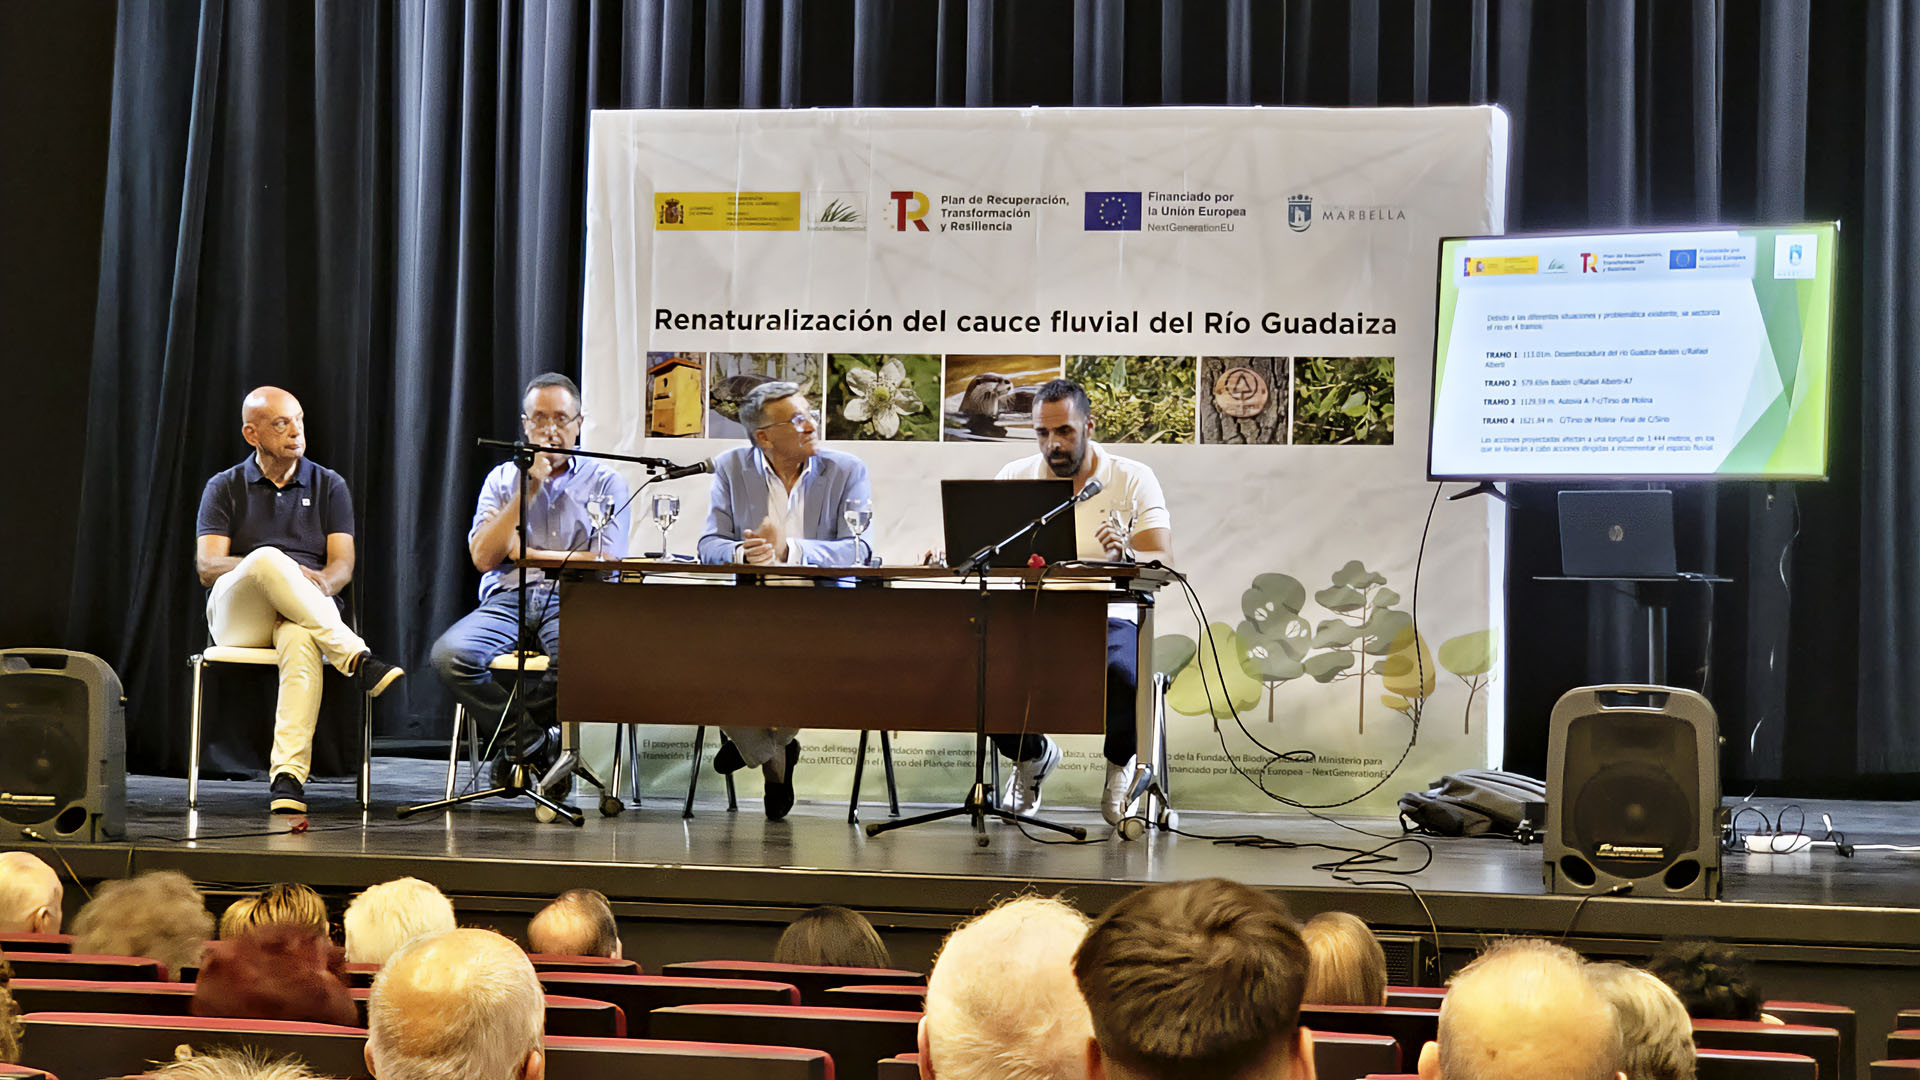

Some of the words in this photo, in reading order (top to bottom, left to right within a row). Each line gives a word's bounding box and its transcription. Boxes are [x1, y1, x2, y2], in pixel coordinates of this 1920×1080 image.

[941, 195, 965, 205] Plan
[968, 195, 983, 205] de
[987, 195, 1070, 207] Recuperación,
[1148, 192, 1212, 202] Financiado
[1215, 193, 1234, 204] por
[941, 208, 1031, 218] Transformación
[1148, 206, 1158, 216] la
[1161, 206, 1195, 216] Unión
[1198, 206, 1247, 219] Europea
[1322, 209, 1406, 221] MARBELLA
[940, 223, 947, 232] y
[950, 221, 1013, 232] Resiliencia
[1147, 223, 1235, 232] NextGenerationEU
[654, 308, 893, 332] Renaturalización
[902, 309, 947, 333] del
[956, 314, 1041, 333] cauce
[1051, 310, 1139, 334] fluvial
[1149, 311, 1193, 334] del
[1204, 311, 1251, 335] Río
[1261, 312, 1397, 335] Guadaiza
[1486, 351, 1512, 359] TRAMO
[1484, 379, 1511, 387] TRAMO
[1483, 398, 1510, 406] TRAMO
[1482, 417, 1509, 425] TRAMO
[643, 739, 651, 748] El
[651, 740, 690, 750] proyecto
[642, 751, 685, 761] Transición
[822, 745, 836, 753] del
[837, 745, 858, 755] riesg
[937, 748, 946, 756] el
[947, 749, 976, 757] entorn
[908, 759, 921, 768] del
[923, 760, 941, 768] Plan
[942, 760, 956, 768] de
[1173, 752, 1185, 761] de
[1187, 752, 1195, 761] la
[1318, 755, 1361, 765] Ministerio
[1363, 758, 1383, 767] para
[1168, 766, 1211, 775] inanciado
[1212, 767, 1228, 776] por
[1267, 767, 1304, 777] Europea
